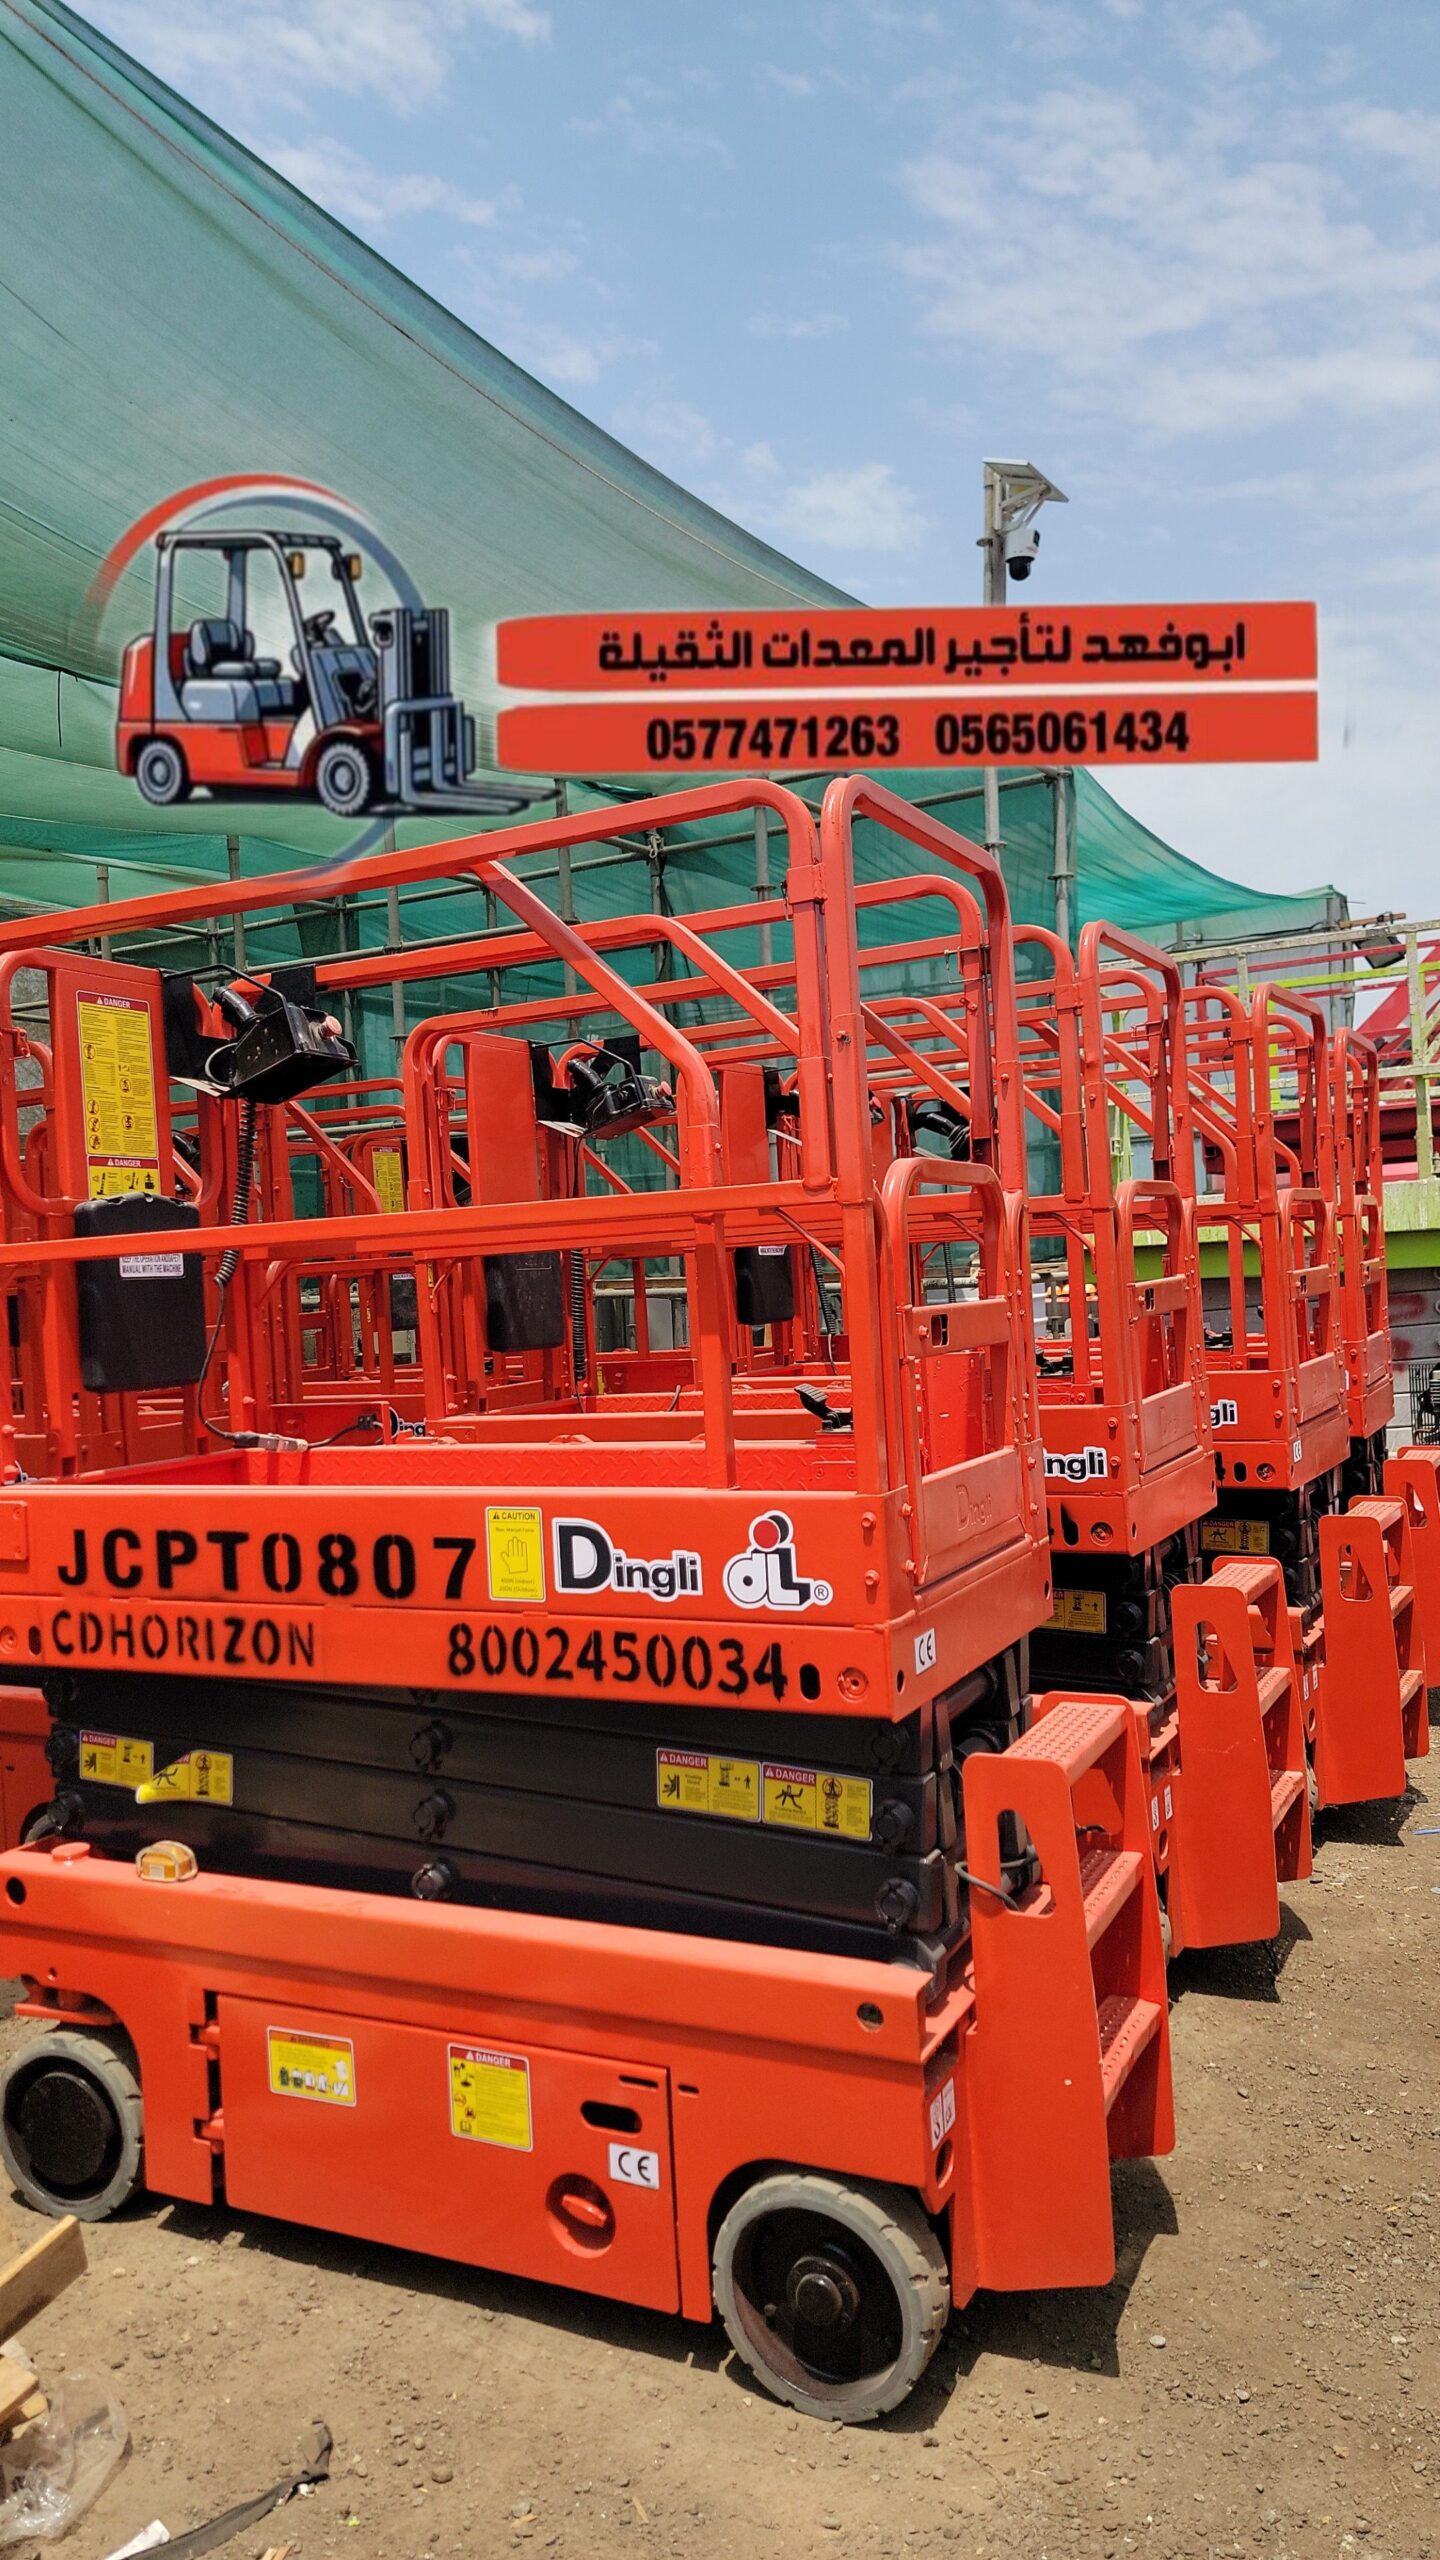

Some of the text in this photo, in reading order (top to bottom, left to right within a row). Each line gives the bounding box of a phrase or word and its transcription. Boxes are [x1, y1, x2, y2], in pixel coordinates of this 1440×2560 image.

[103, 998, 131, 1009] DANGER
[114, 1159, 141, 1167] DANGER
[501, 1512, 536, 1520] CAUTION
[57, 1528, 477, 1600] JCPT0807
[556, 1521, 700, 1598] Dingli
[52, 1609, 316, 1668] CDHORIZON
[918, 1634, 933, 1666] CE
[447, 1622, 789, 1703] 8002450034
[89, 1735, 117, 1747] DANGER
[669, 1753, 708, 1768] DANGER
[775, 1769, 815, 1784] DANGER
[476, 2052, 511, 2068] DANGER
[618, 2151, 651, 2183] CE
